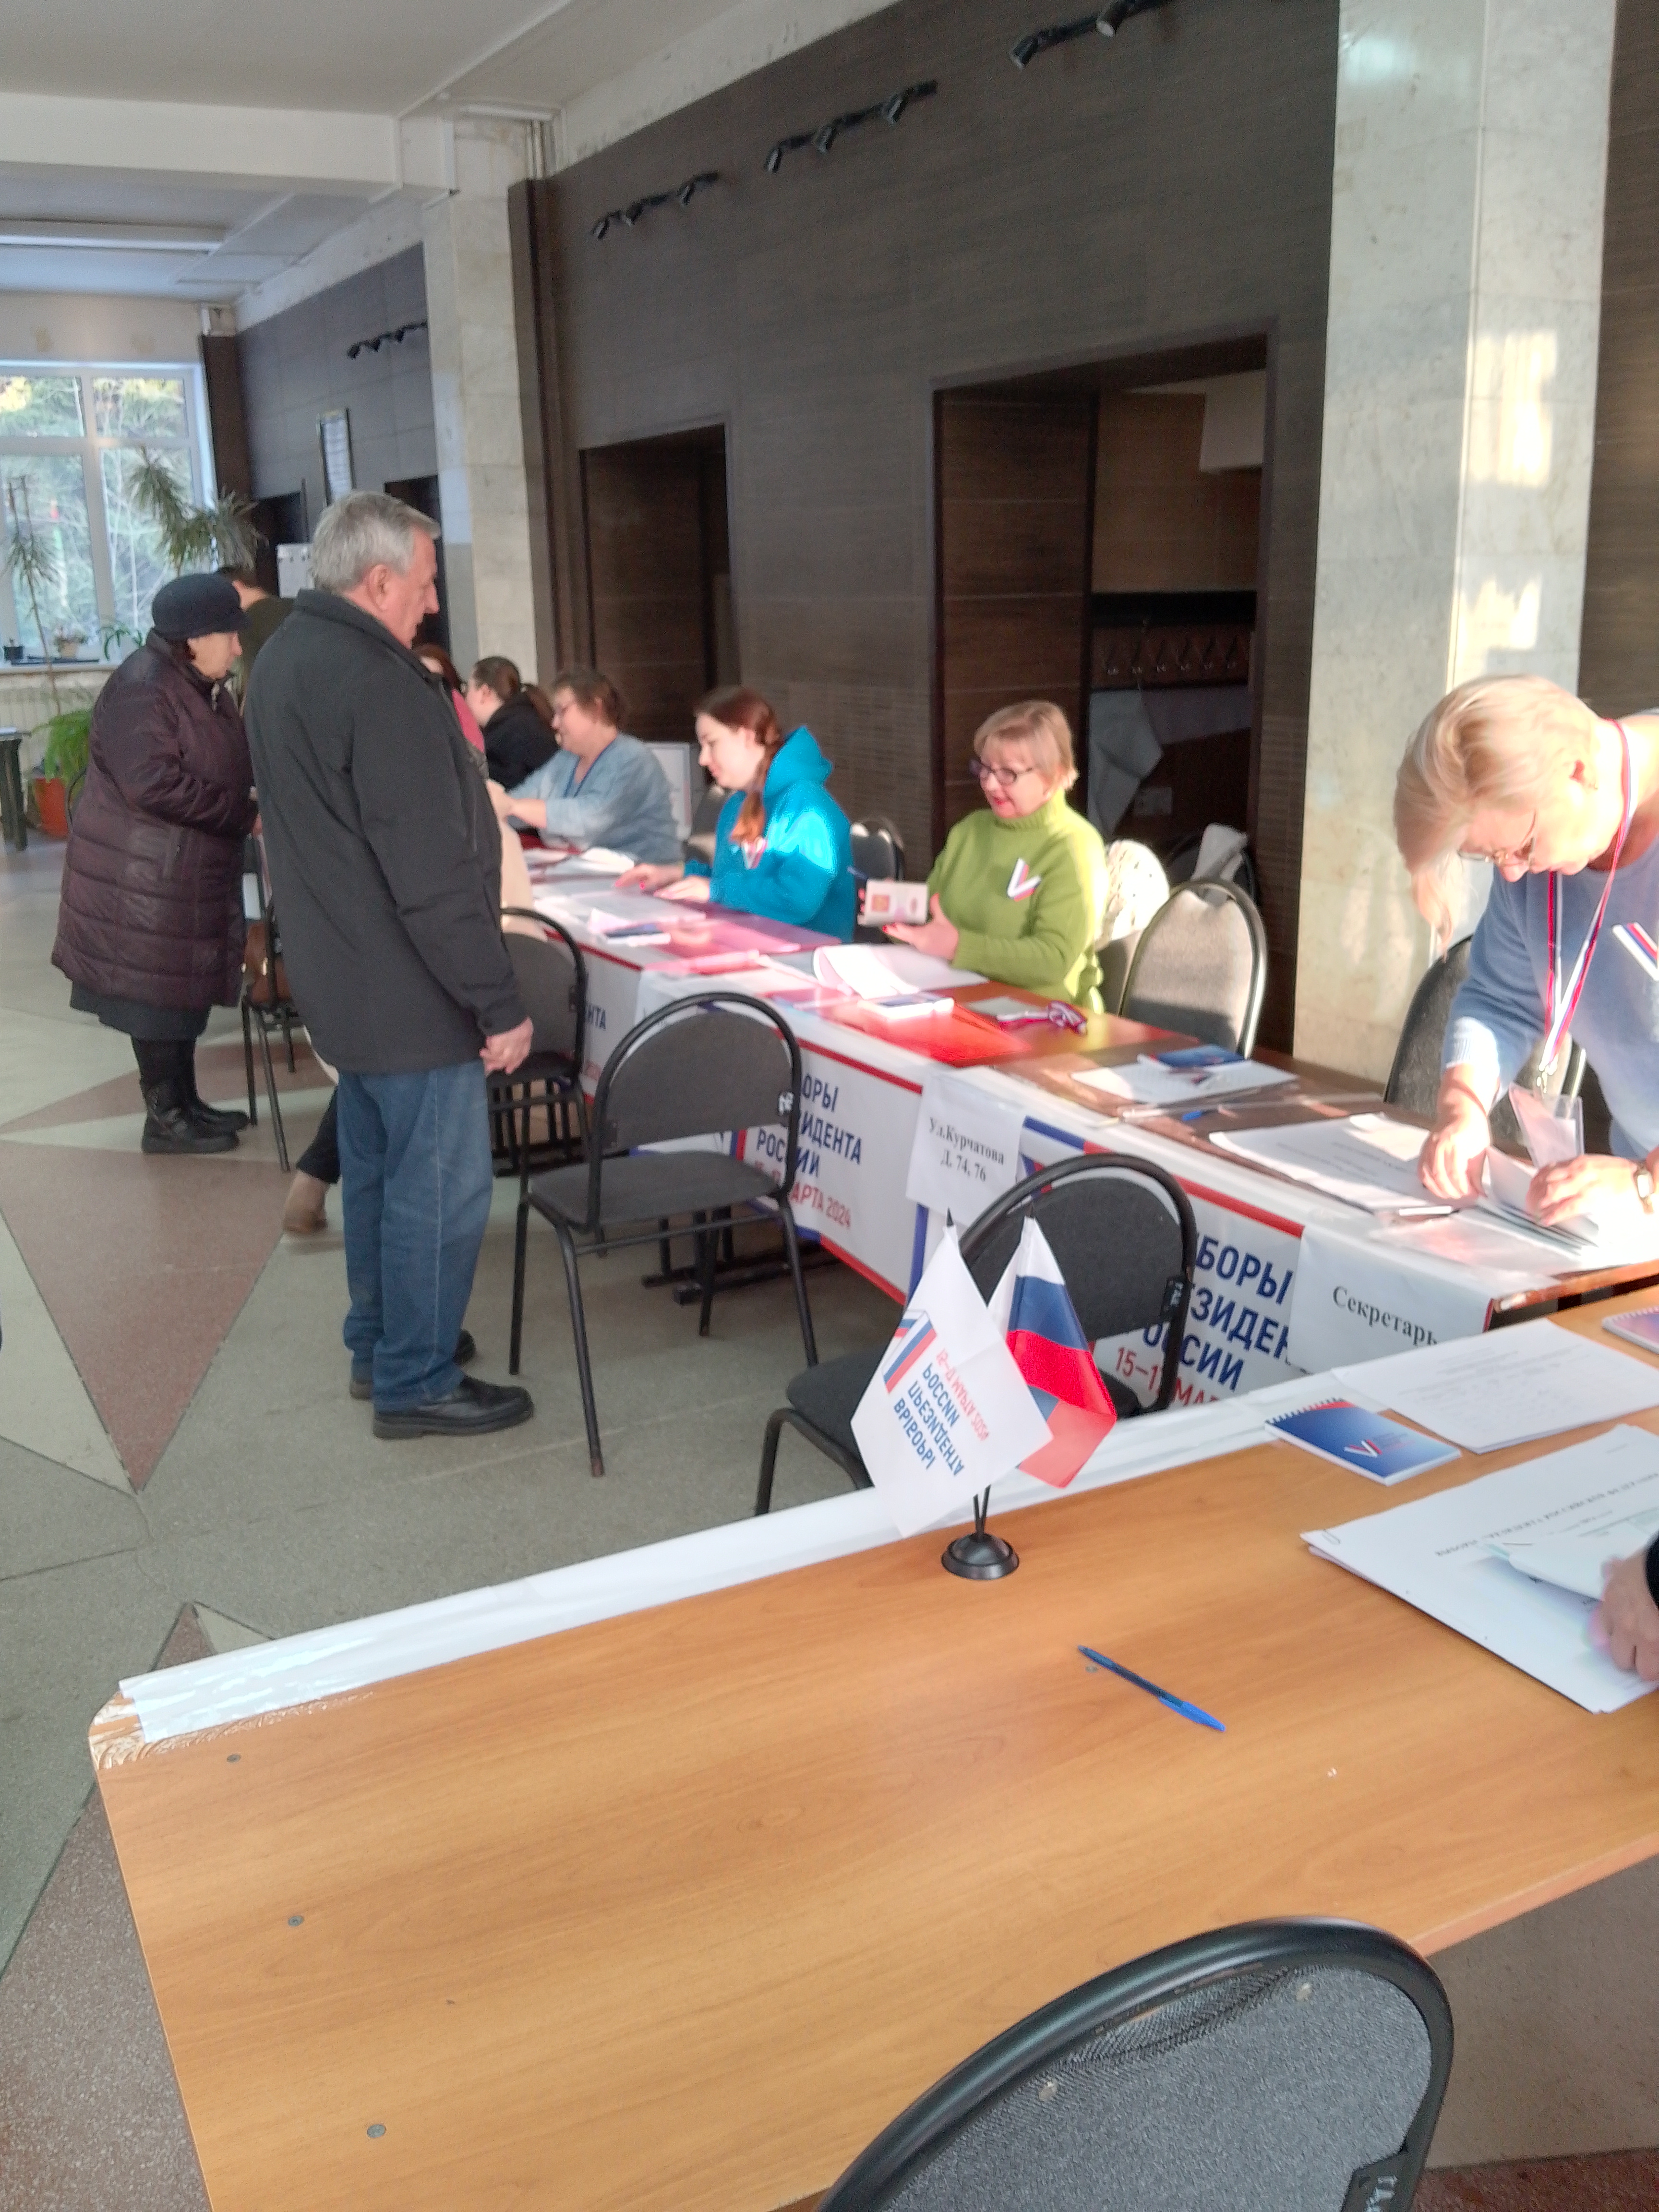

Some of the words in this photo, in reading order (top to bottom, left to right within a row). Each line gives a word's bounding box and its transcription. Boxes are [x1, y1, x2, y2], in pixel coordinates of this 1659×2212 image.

[801, 1073, 839, 1113] ОРЫ
[756, 1128, 820, 1177] РОСИИ
[800, 1109, 861, 1165] ИДЕНТА
[789, 1182, 823, 1212] АРТА
[974, 1163, 986, 1182] 76
[1195, 1235, 1293, 1305] БОРЫ
[1333, 1286, 1437, 1346] Секретарь
[1143, 1323, 1244, 1392] ОСИИ
